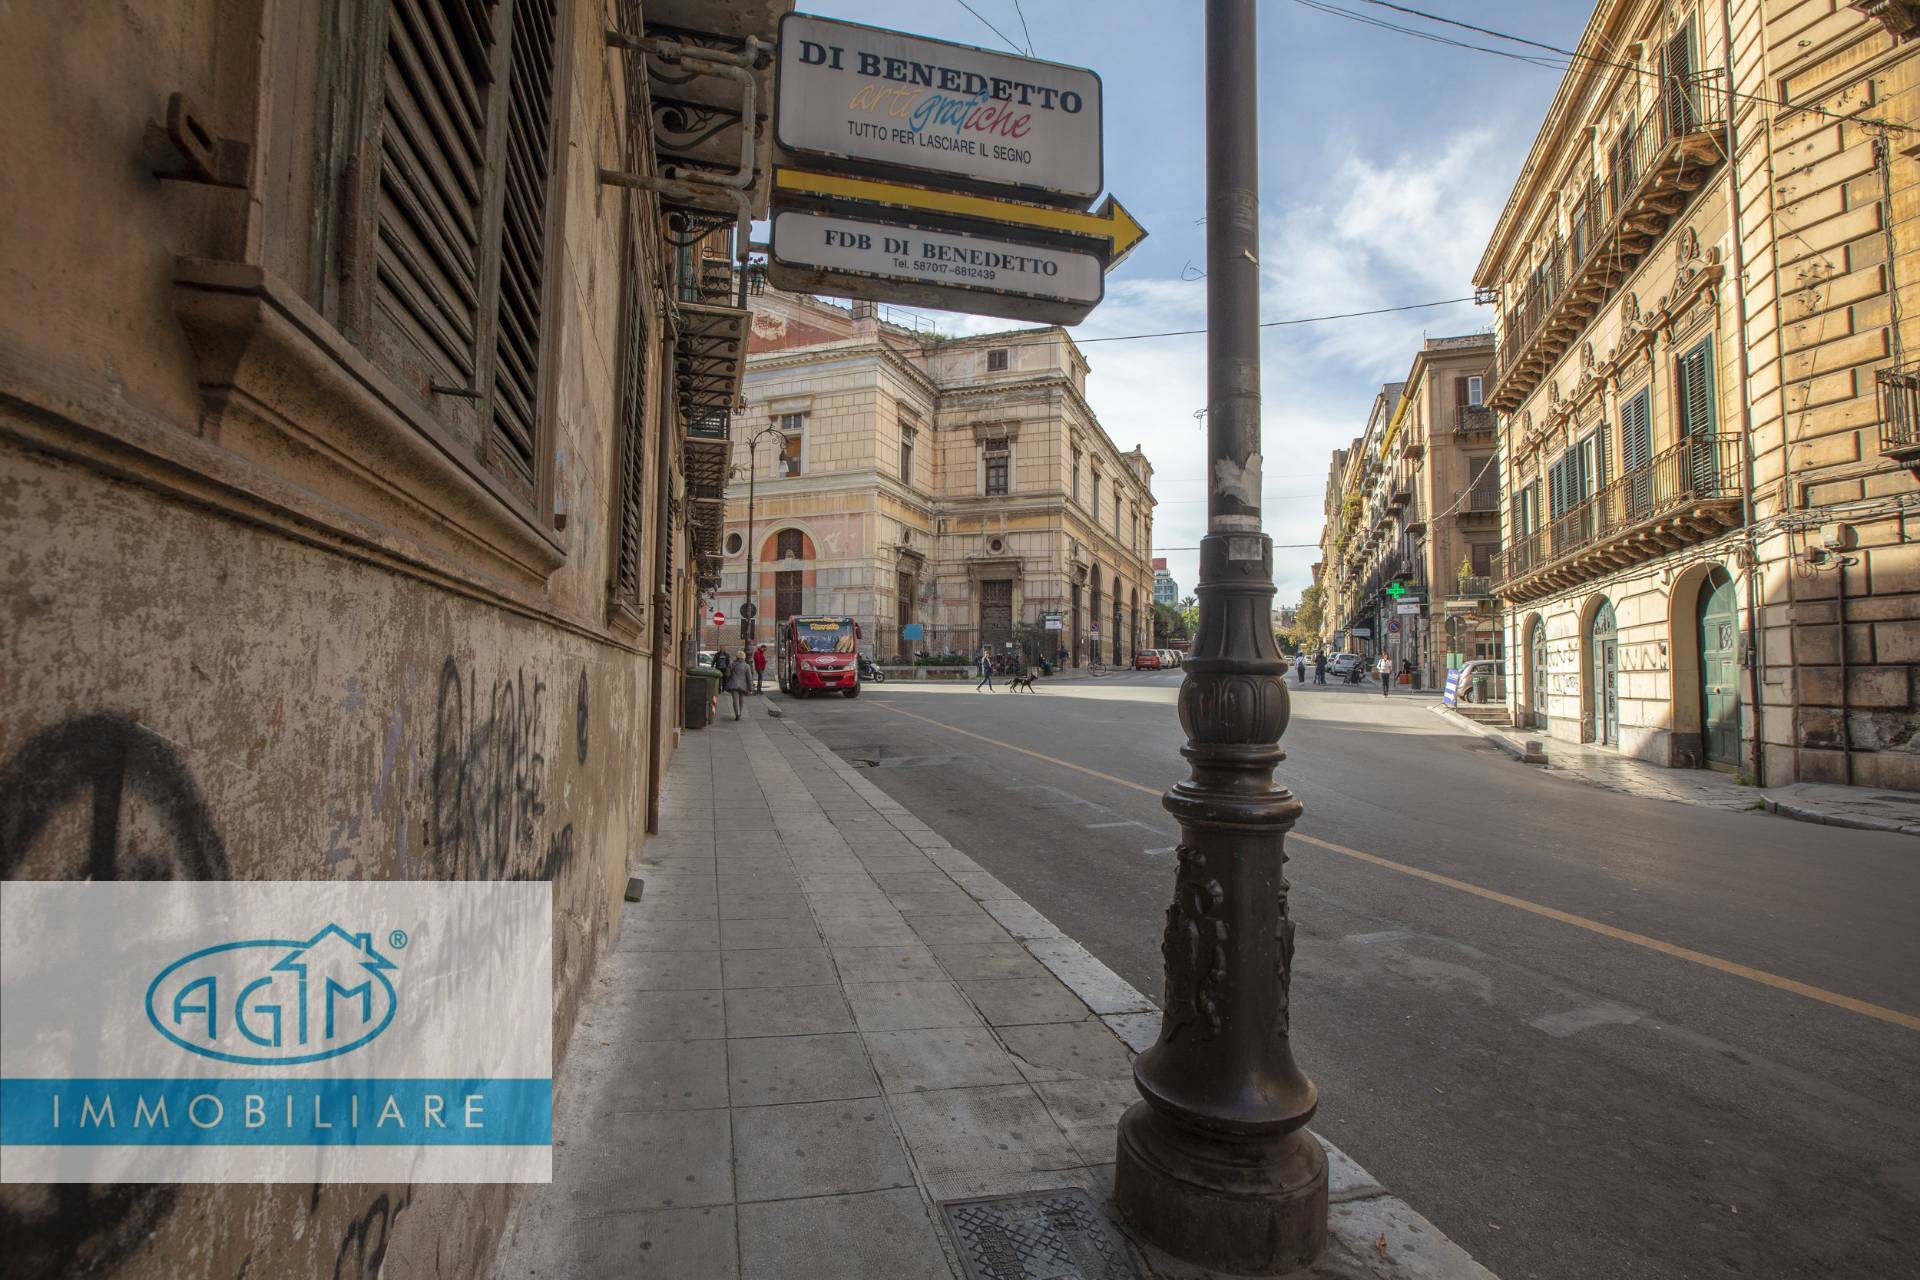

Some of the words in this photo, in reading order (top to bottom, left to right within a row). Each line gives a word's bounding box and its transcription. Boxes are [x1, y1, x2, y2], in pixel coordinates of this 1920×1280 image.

[799, 40, 844, 70] DI
[857, 52, 1082, 113] BENEDETTO
[848, 120, 887, 141] TUTTO
[892, 128, 914, 145] PER
[919, 133, 976, 155] LASCIARE
[979, 143, 989, 158] IL
[993, 145, 1032, 165] SEGNO
[824, 229, 871, 250] FDB
[884, 237, 910, 256] DI
[923, 243, 1058, 276] BENEDETTO
[892, 258, 909, 269] Tel.
